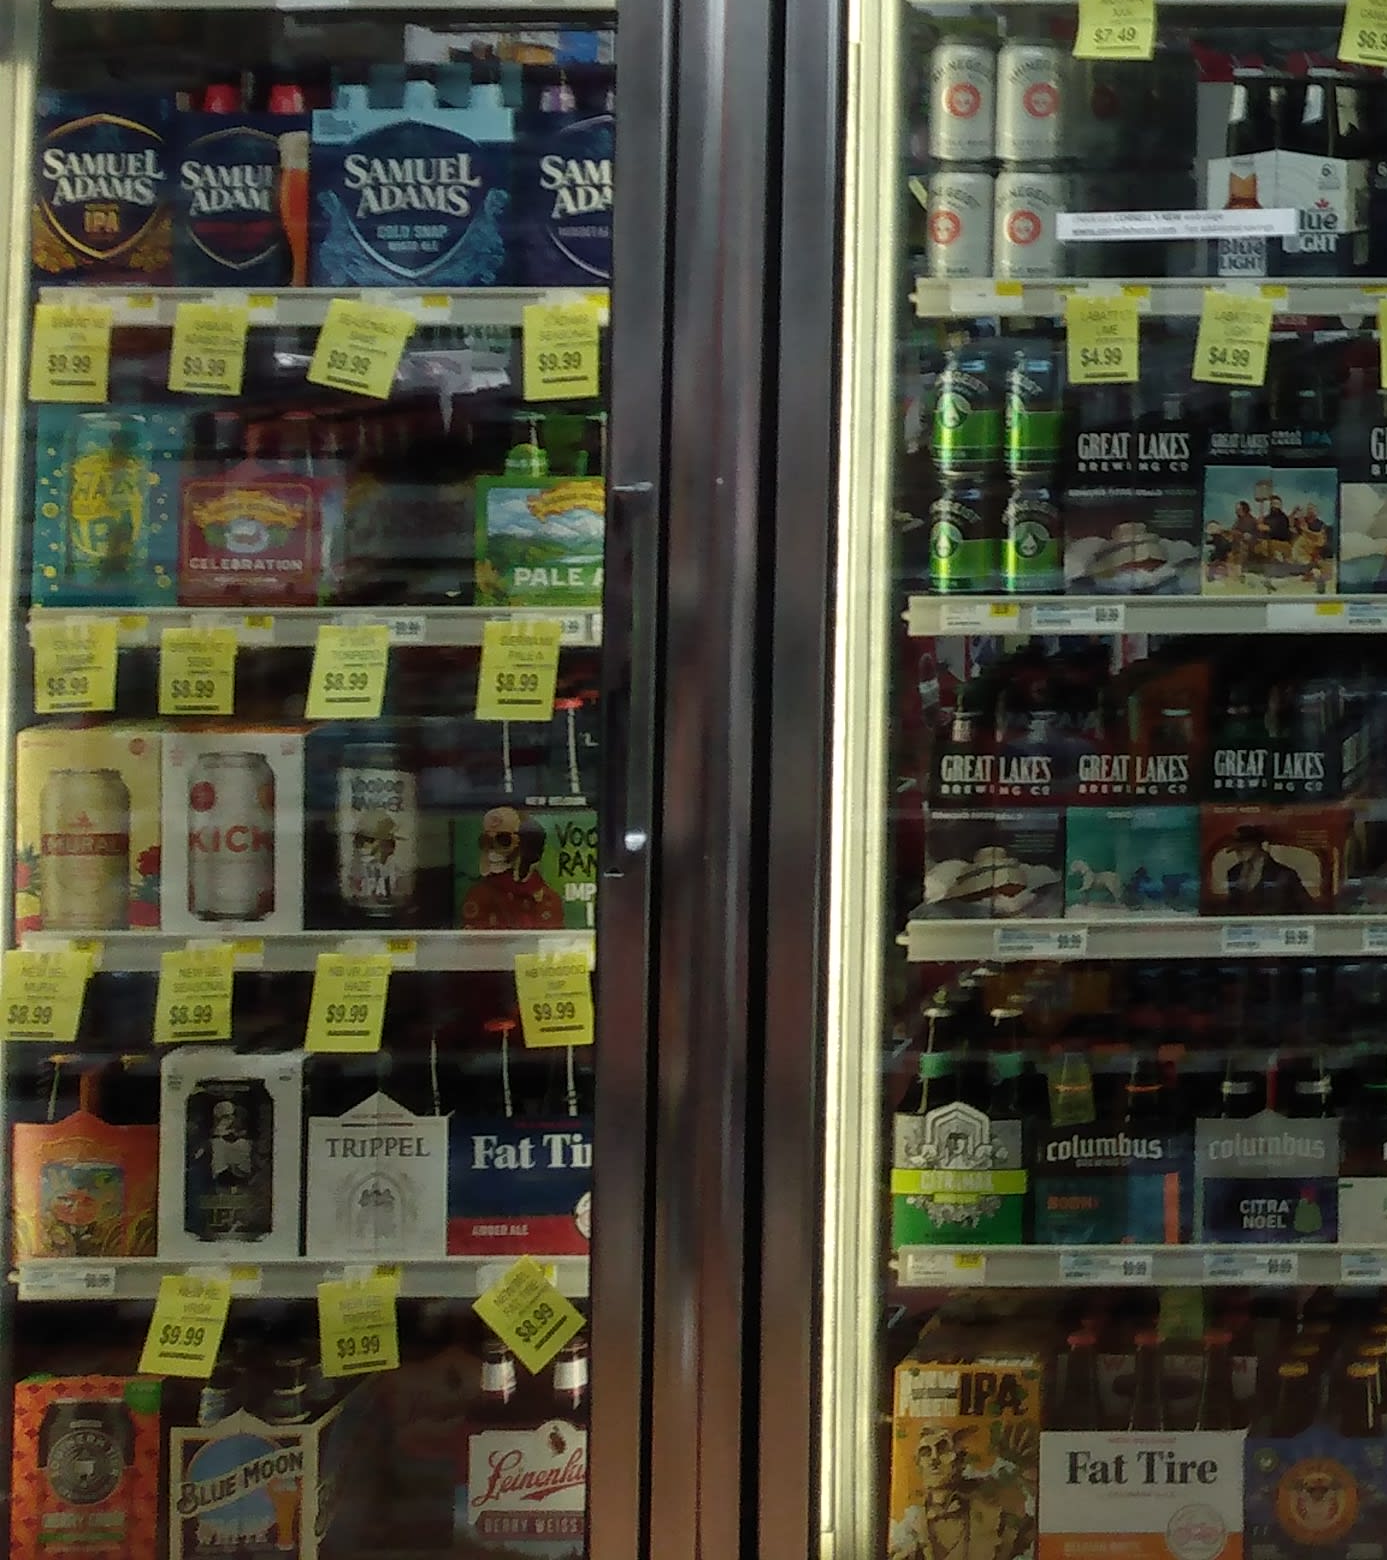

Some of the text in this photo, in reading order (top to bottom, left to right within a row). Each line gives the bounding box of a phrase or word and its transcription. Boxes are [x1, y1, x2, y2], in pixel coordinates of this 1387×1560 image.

[1093, 26, 1137, 44] $7.49
[42, 148, 168, 180] SAMUEL
[344, 152, 482, 190] SAMUEL
[51, 177, 157, 207] ADAMS
[356, 186, 472, 219] ADAMS
[1080, 346, 1123, 368] $4.99
[1207, 345, 1250, 368] $4.99
[1077, 432, 1191, 462] GREAT LAKES
[1077, 461, 1161, 473] BREWING
[188, 557, 303, 571] CELEBRATION
[514, 567, 584, 586] PALE
[940, 755, 1053, 784] GREAT LAKES
[1078, 754, 1190, 783] GREAT LAKES
[1213, 749, 1325, 782] GREAT LAKES
[940, 783, 1022, 796] BREWING
[1078, 783, 1159, 796] BREWING
[1213, 779, 1295, 794] BREWING
[9, 1005, 53, 1024] $8.99
[325, 1004, 368, 1023] $9.99
[325, 1136, 431, 1159] TRIPPEL
[471, 1135, 536, 1170] Fat
[1045, 1140, 1163, 1164] columbus
[1207, 1139, 1327, 1161] columbus
[1239, 1200, 1290, 1215] CITRA
[1242, 1214, 1287, 1230] NOEL
[159, 1323, 205, 1347] $9.99
[336, 1334, 381, 1358] $9.99
[958, 1372, 1028, 1417] IPA
[1066, 1449, 1219, 1486] Fat Tire
[177, 1451, 304, 1516] BLUE MOON
[484, 1518, 578, 1533] BERRY WEISS
